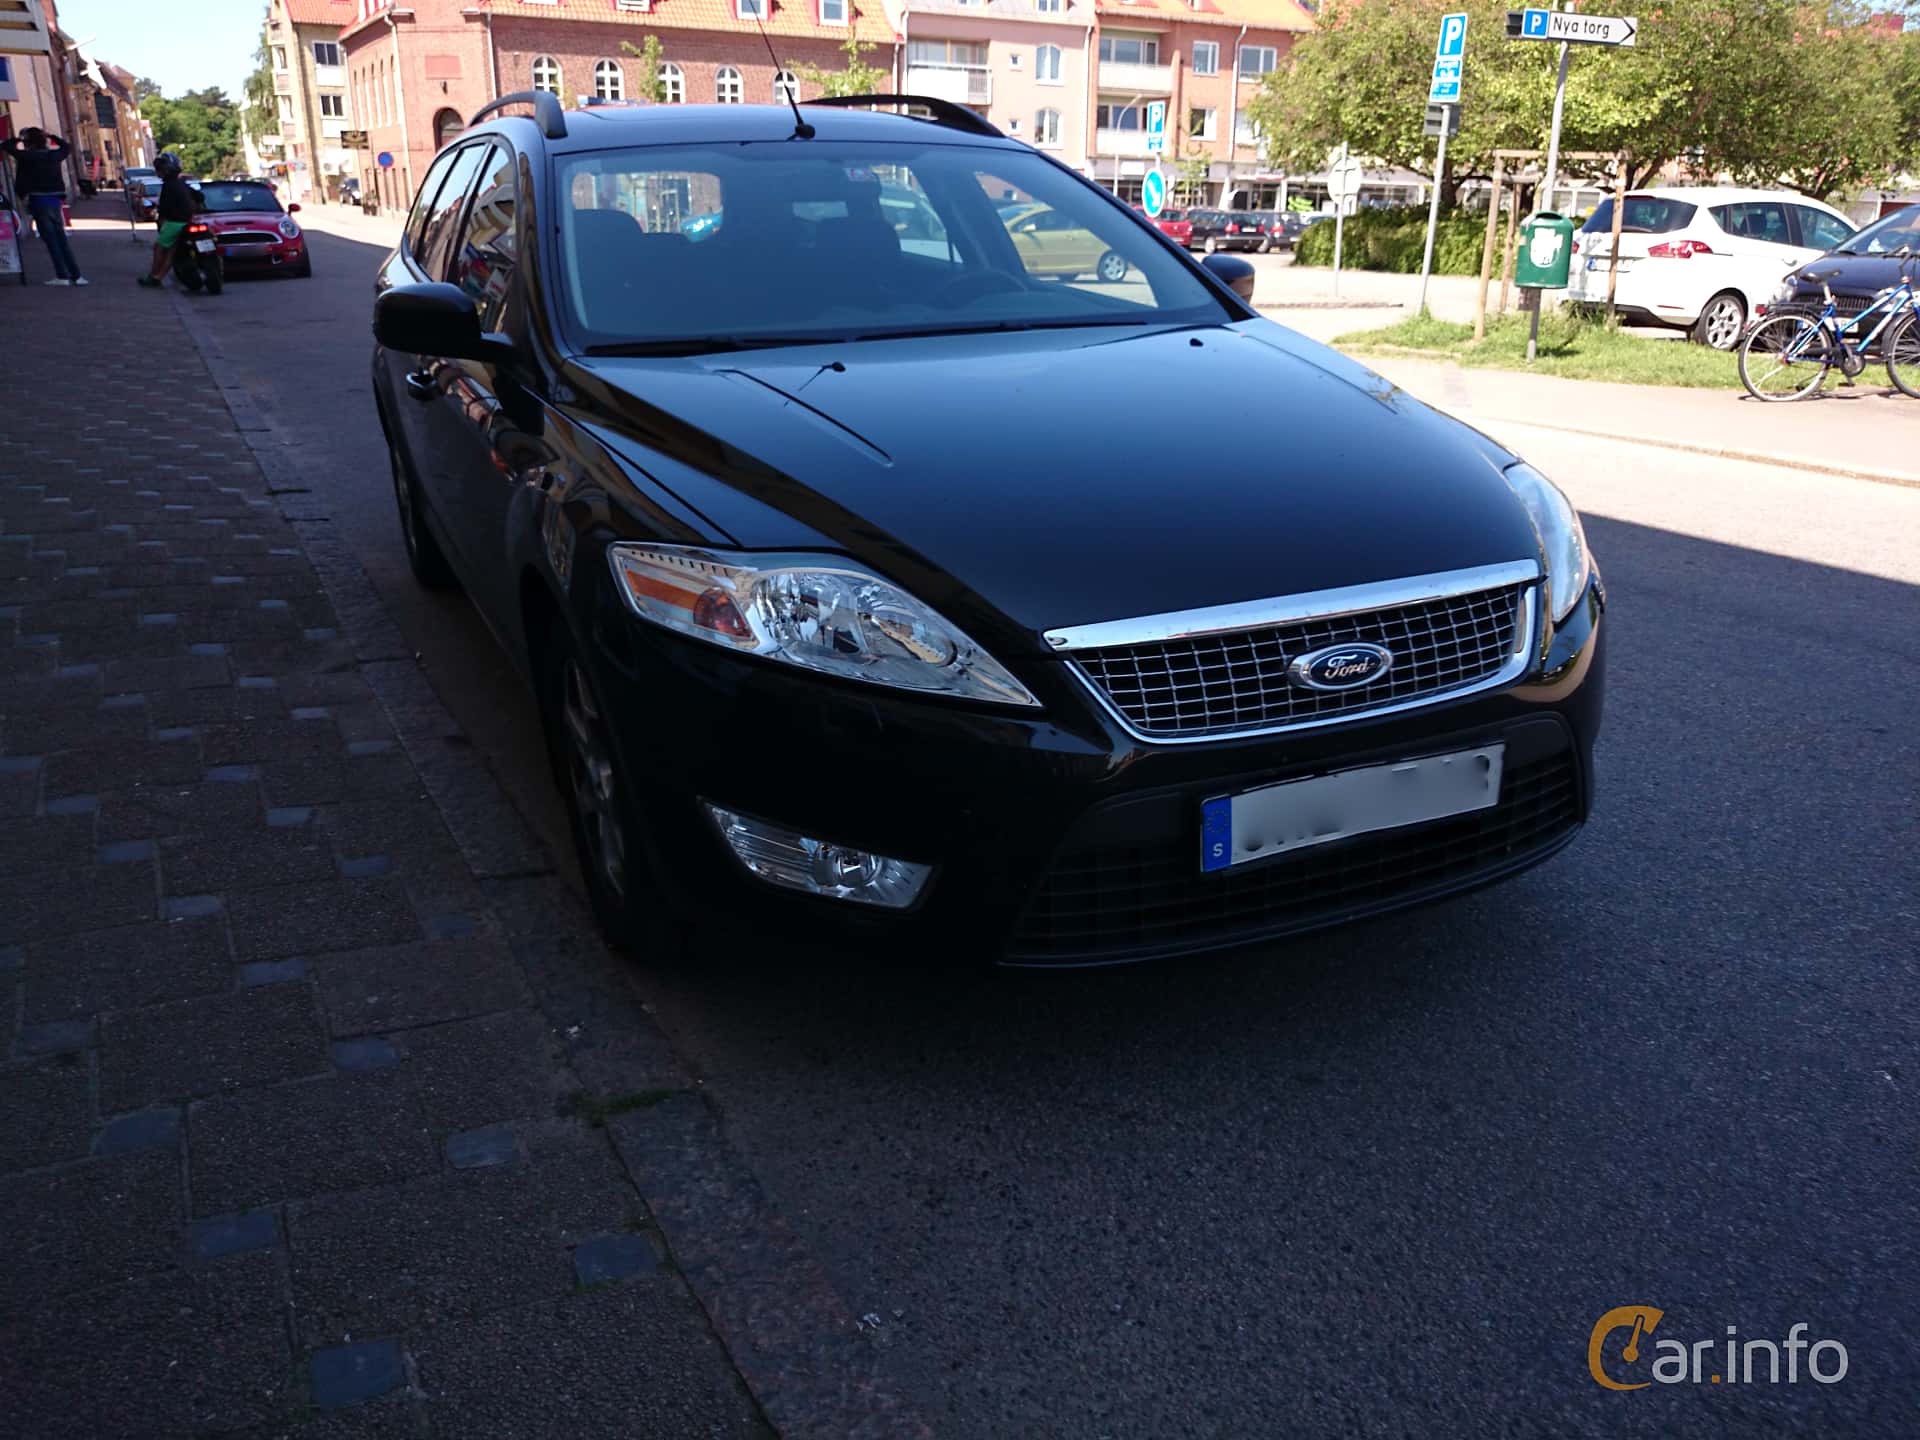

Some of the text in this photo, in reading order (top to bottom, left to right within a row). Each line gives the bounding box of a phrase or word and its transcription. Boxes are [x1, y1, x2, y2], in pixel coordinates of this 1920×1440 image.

[1444, 18, 1462, 54] P
[1531, 14, 1610, 39] P Nya torg
[1151, 104, 1162, 132] P
[1324, 654, 1374, 680] Ford
[1212, 842, 1223, 857] S
